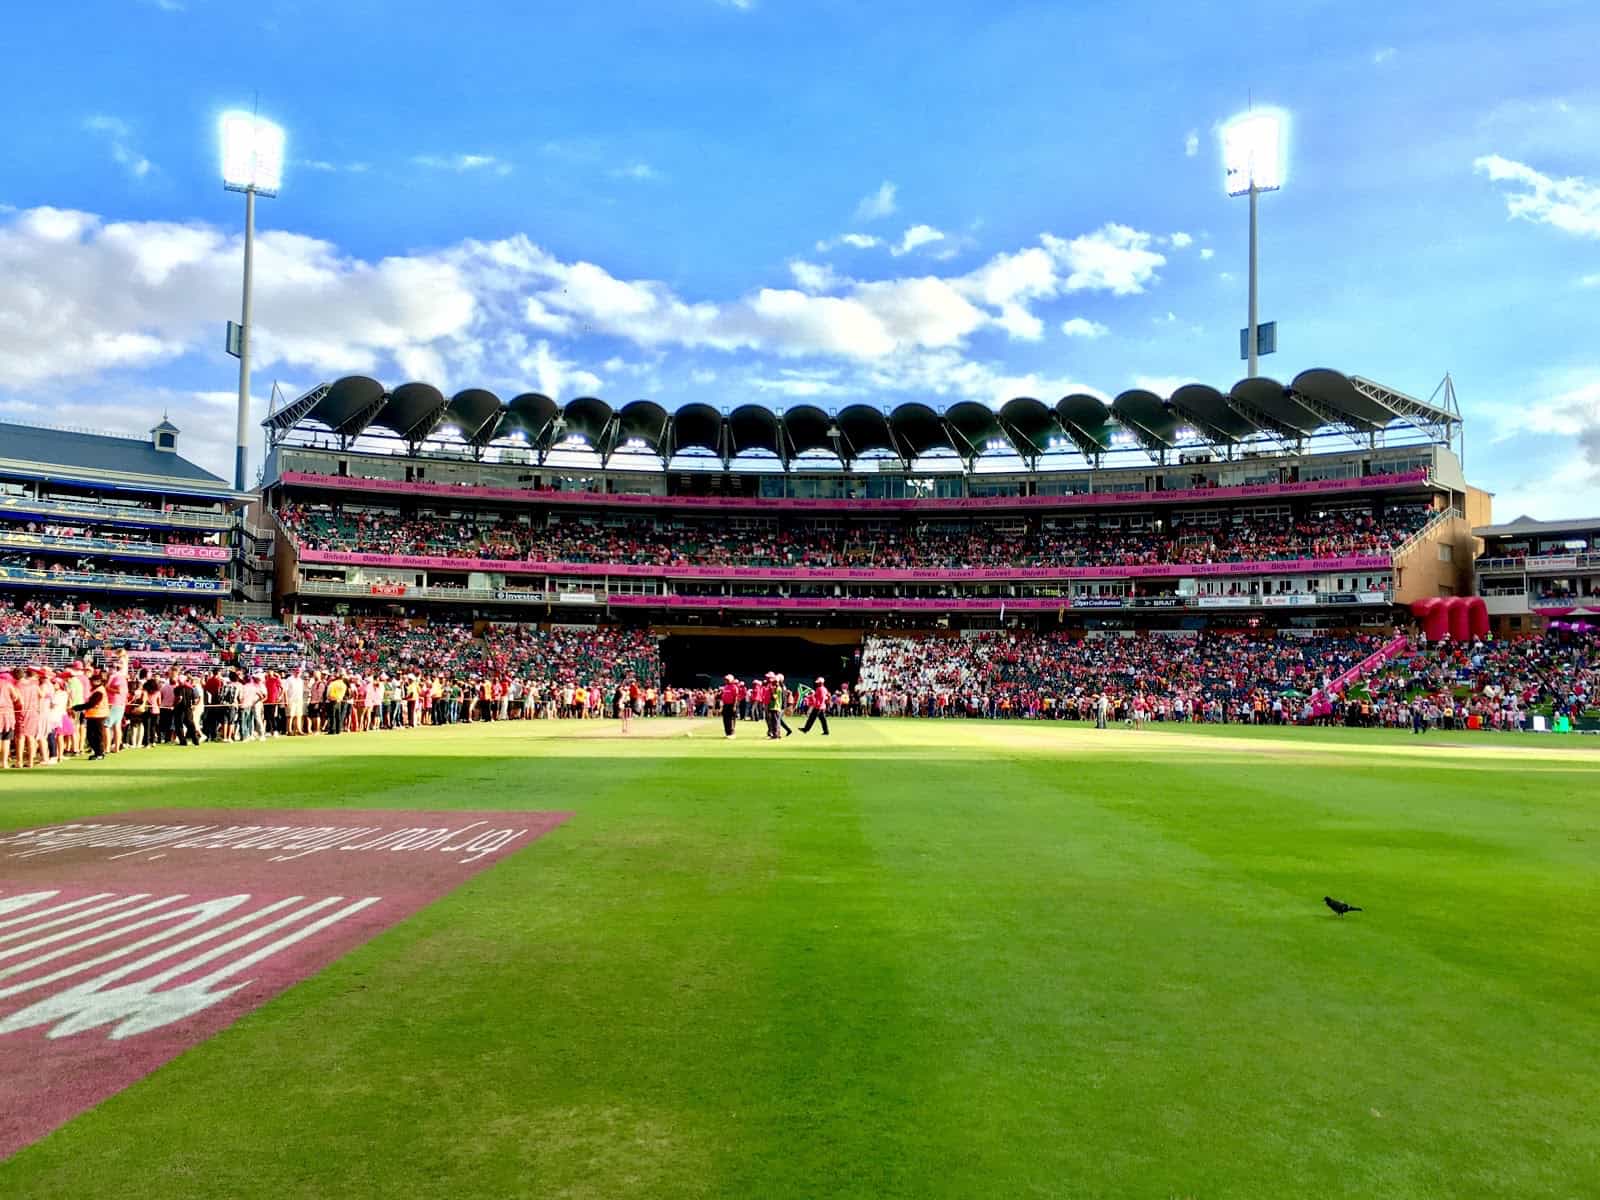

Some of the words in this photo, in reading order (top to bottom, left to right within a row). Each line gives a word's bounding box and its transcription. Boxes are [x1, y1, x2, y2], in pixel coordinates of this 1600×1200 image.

[168, 547, 195, 556] circa
[199, 548, 226, 557] circa
[108, 825, 382, 861] financial
[339, 820, 488, 851] your
[440, 828, 528, 864] for
